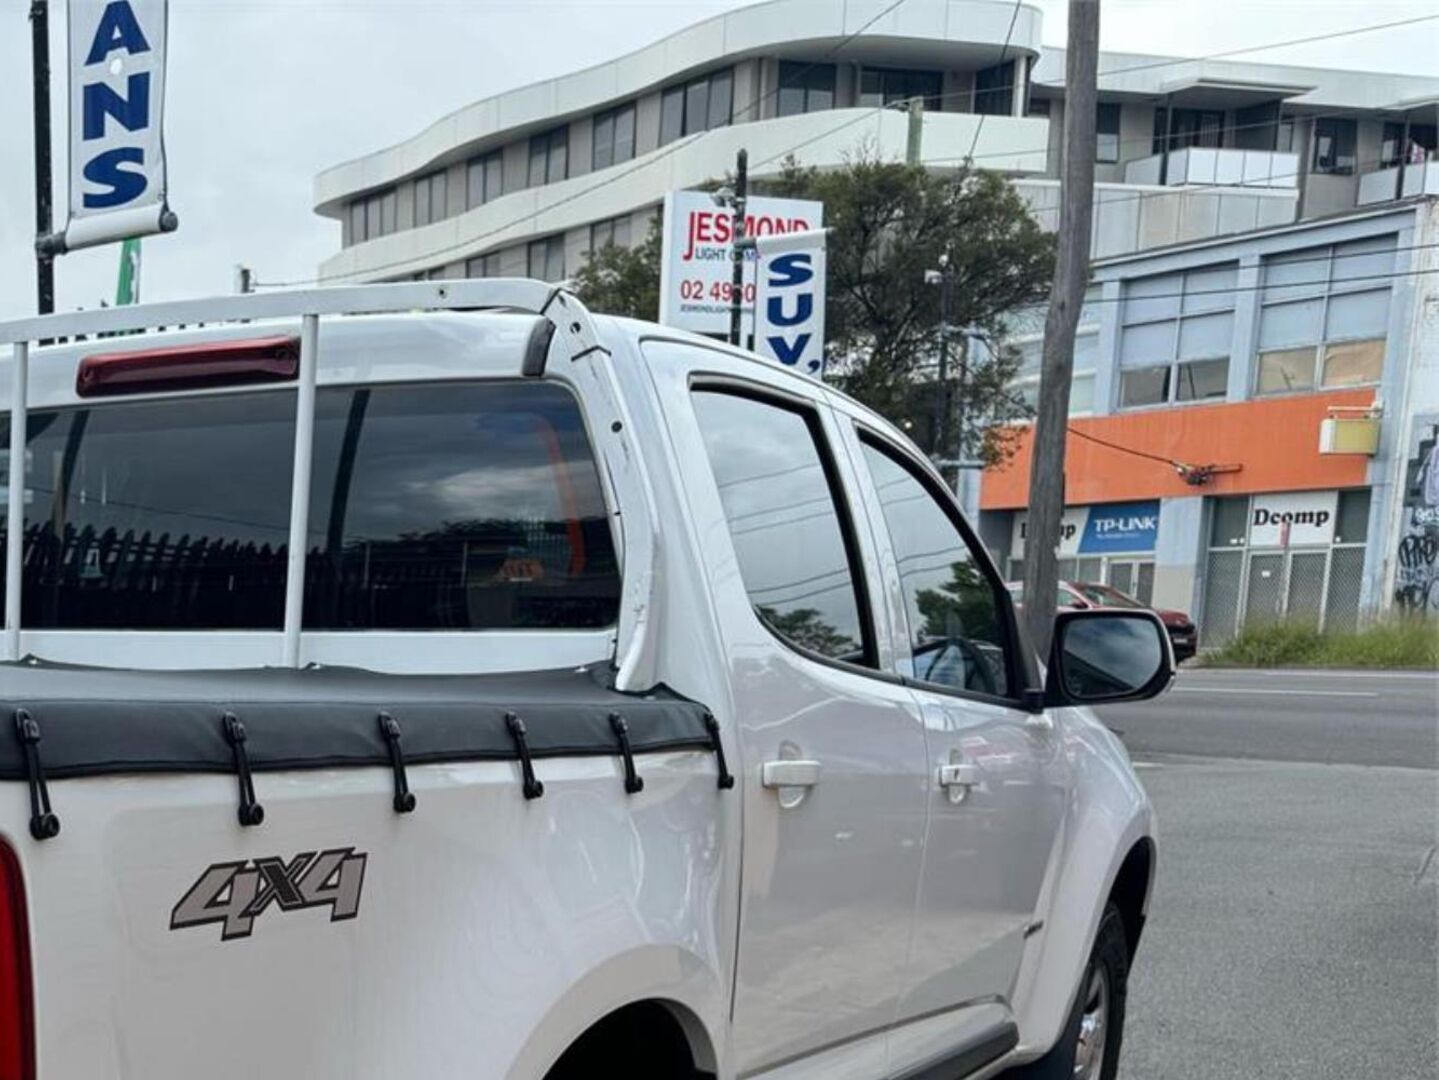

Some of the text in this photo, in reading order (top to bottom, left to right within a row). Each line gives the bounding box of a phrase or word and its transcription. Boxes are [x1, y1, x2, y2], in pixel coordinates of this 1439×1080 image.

[696, 247, 726, 261] LIGHT
[681, 280, 756, 303] 02 490
[1094, 516, 1156, 532] TP-LINK
[1253, 509, 1329, 527] Dcomp
